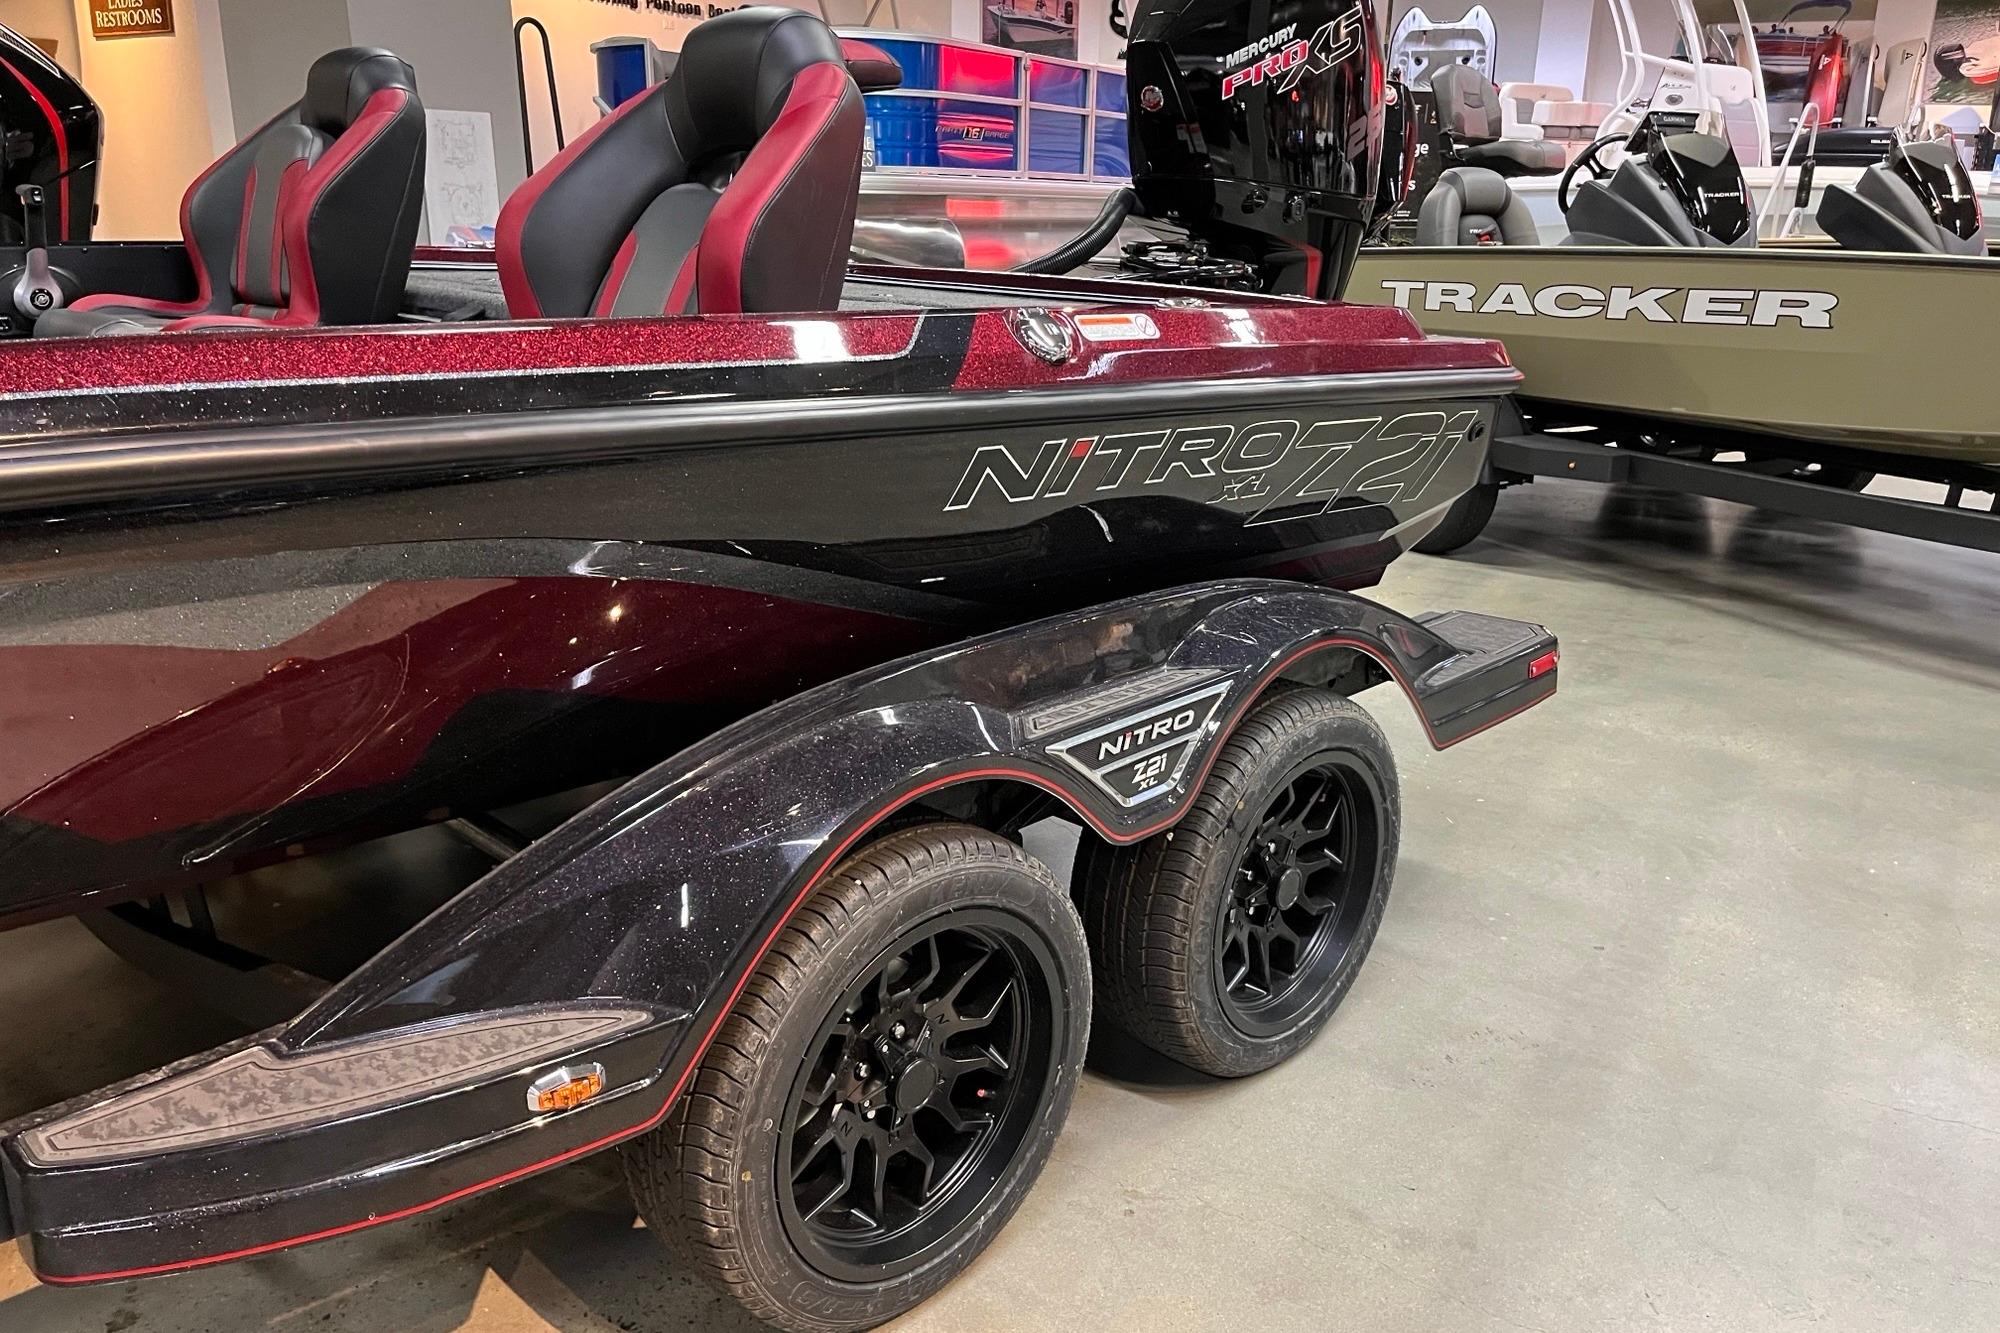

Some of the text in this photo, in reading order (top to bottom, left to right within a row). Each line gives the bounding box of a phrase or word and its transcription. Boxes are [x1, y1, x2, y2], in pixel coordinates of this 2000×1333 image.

[95, 8, 162, 28] RESTROOMS
[1226, 23, 1297, 69] MERCURY
[1222, 40, 1309, 100] PRO
[1381, 280, 1839, 329] TRACKER
[942, 409, 1479, 527] NITRO Z21
[1098, 709, 1195, 761] NITRO
[1131, 753, 1168, 785] Z21
[1138, 778, 1159, 791] XL
